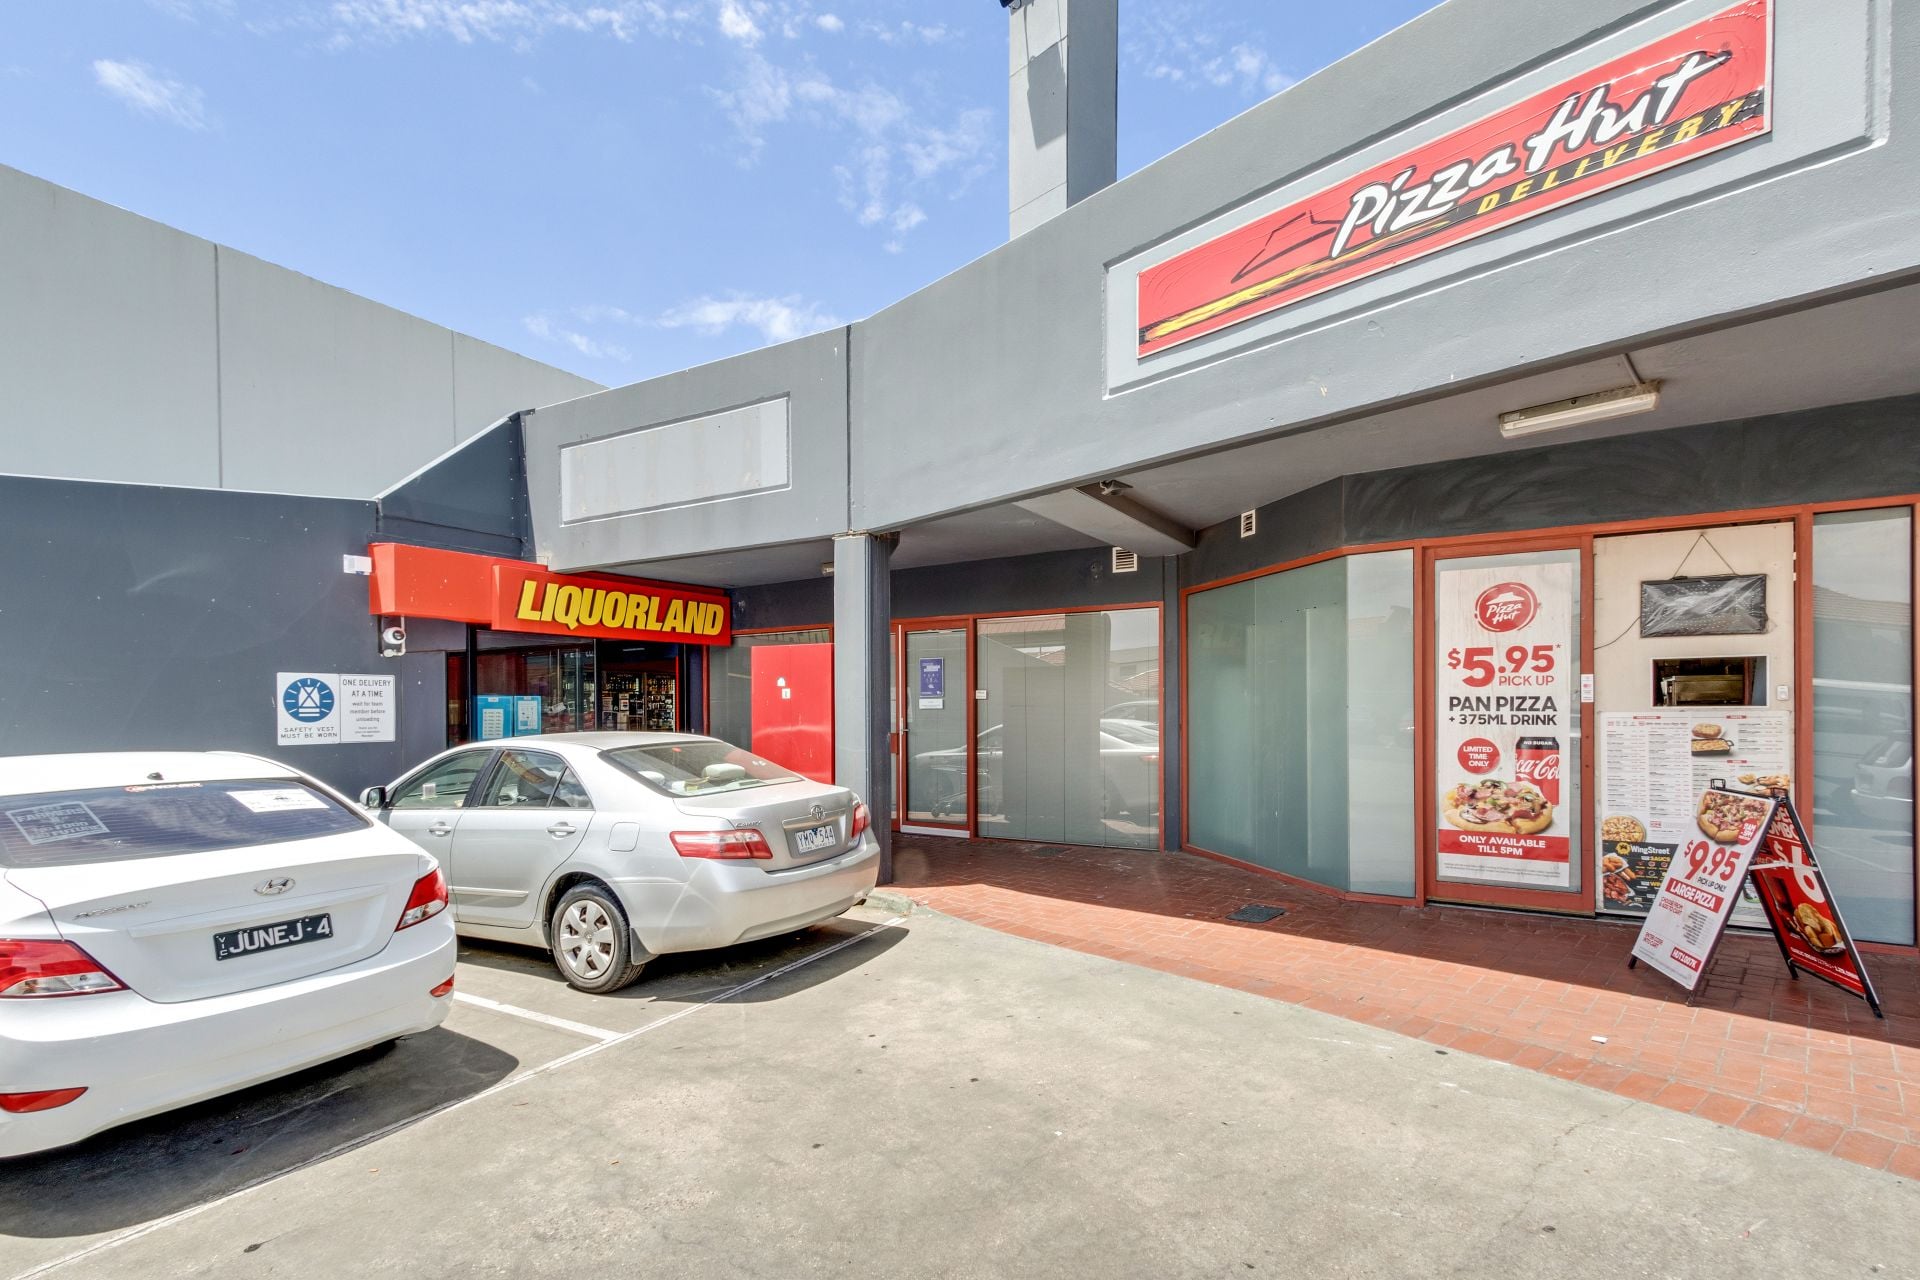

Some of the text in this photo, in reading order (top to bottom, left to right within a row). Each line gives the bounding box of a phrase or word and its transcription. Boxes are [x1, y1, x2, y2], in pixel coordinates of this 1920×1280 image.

[1332, 51, 1731, 258] Pizza Hut
[1477, 100, 1747, 214] DELIVERY
[517, 580, 724, 636] LIQUORLAND
[1486, 602, 1522, 618] Pizza
[1492, 610, 1521, 624] Hut
[359, 679, 391, 687] DELIVERY
[1498, 675, 1554, 686] PICK UP
[1449, 695, 1557, 712] PAN PIZZA
[1458, 714, 1508, 726] 375ML
[1510, 714, 1557, 726] DRINK
[1468, 760, 1490, 768] ONLY
[1459, 834, 1546, 848] ONLY AVAILABLE
[1477, 844, 1523, 856] TILL 5PM
[1631, 845, 1671, 855] WingStreet
[1683, 840, 1742, 882] $9.95
[1670, 880, 1717, 910] LARGE PIZZA
